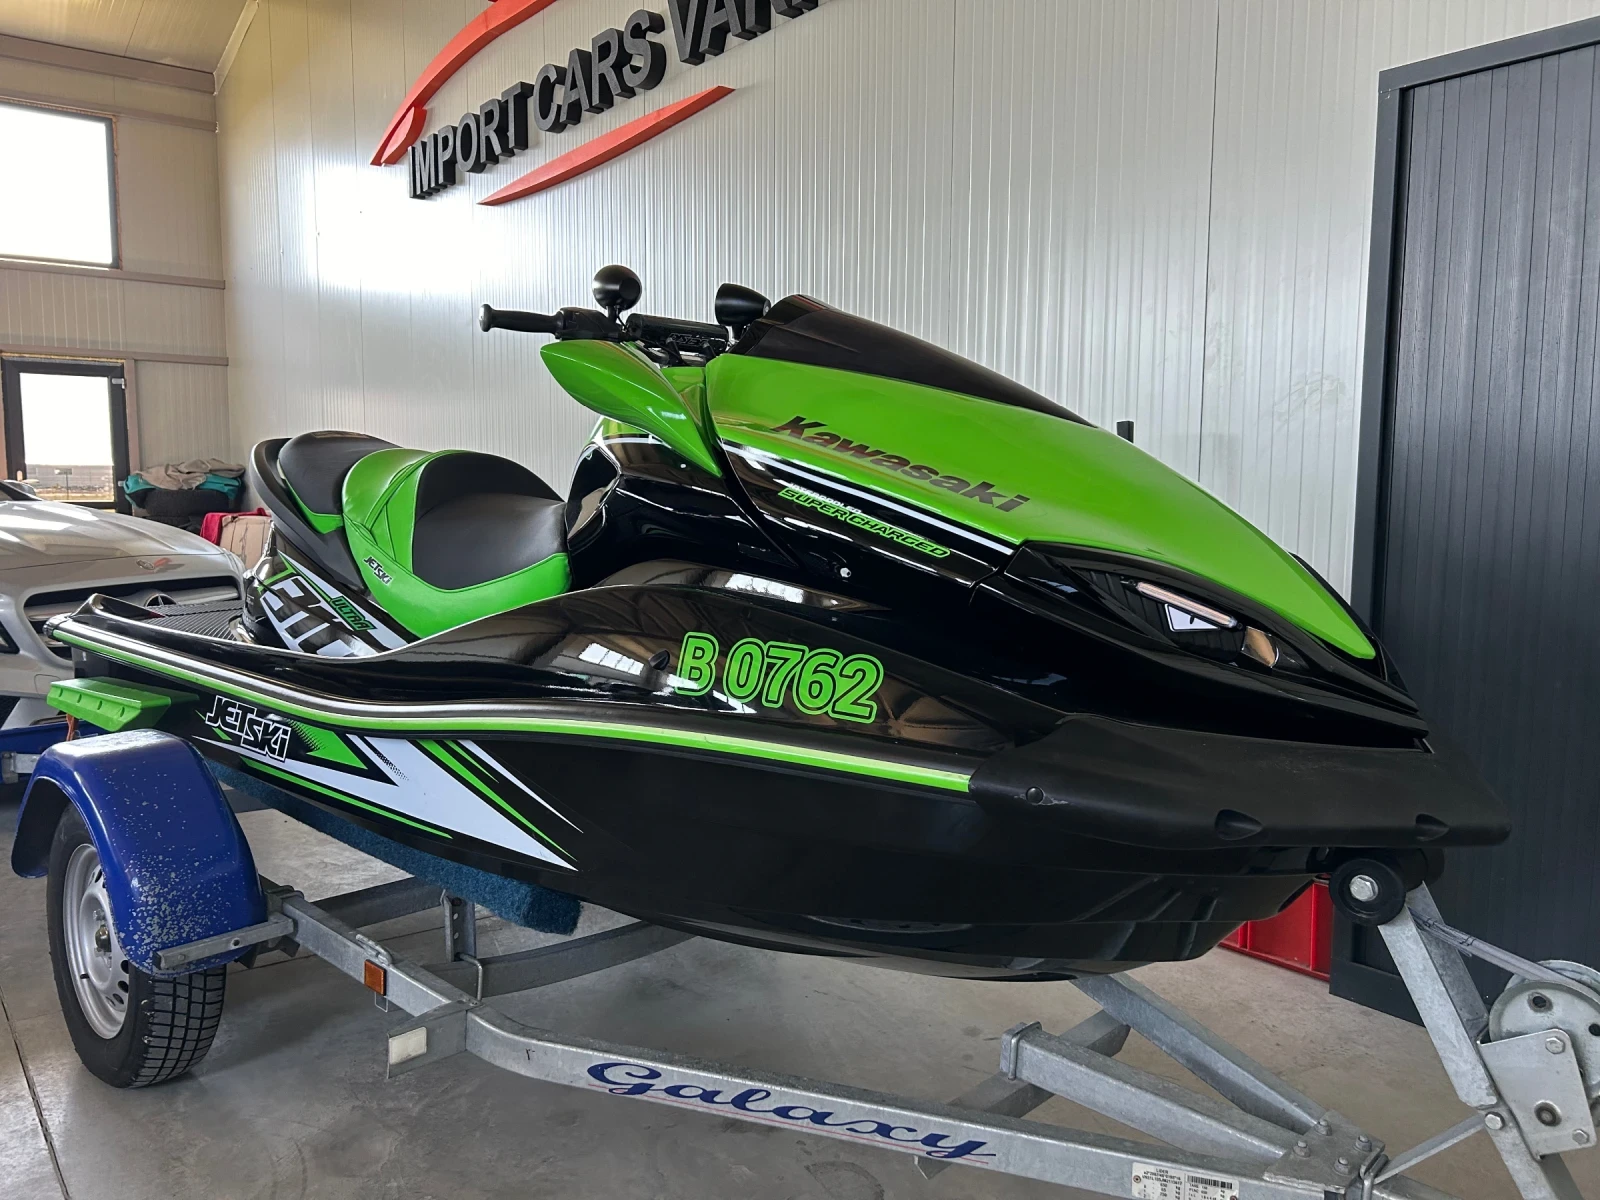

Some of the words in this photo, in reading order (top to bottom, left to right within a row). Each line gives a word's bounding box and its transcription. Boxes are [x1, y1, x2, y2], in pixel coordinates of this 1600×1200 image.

[408, 81, 533, 199] IMPORT
[533, 9, 667, 133] CARS
[771, 416, 1030, 512] Kawasaki
[330, 597, 375, 630] ULTRA
[676, 631, 719, 696] B
[723, 638, 884, 724] 0762
[587, 1062, 996, 1159] Galaxy
